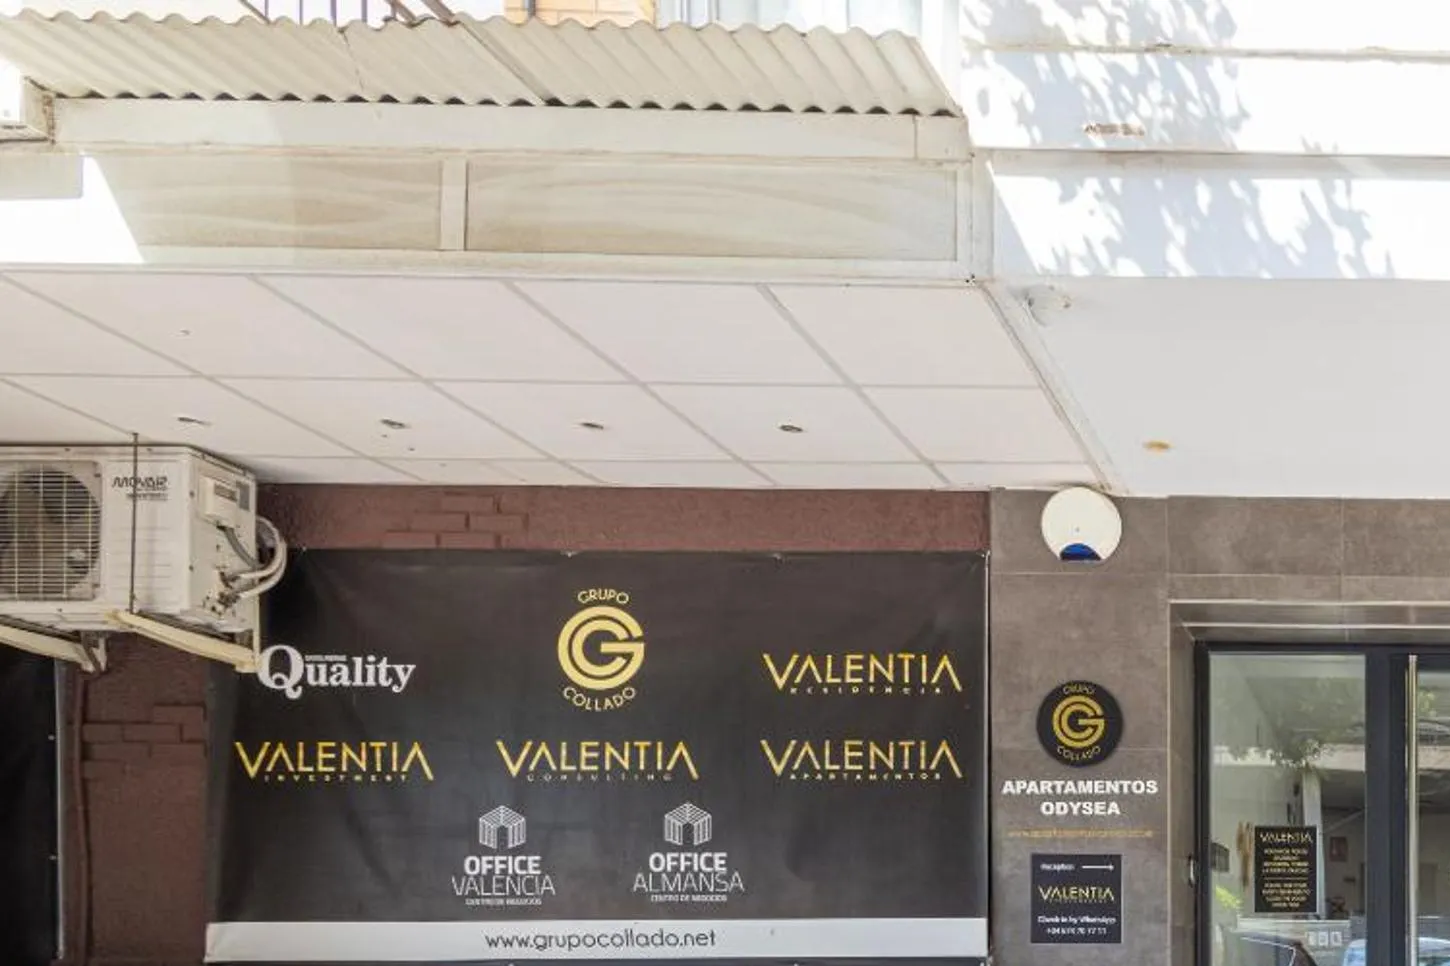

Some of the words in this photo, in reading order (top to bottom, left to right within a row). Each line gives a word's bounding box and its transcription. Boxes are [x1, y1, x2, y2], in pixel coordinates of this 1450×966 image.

[577, 588, 629, 605] GRUPO
[257, 644, 417, 699] Quality
[762, 652, 963, 692] VALENTIA
[563, 686, 636, 711] COLLADO
[234, 741, 434, 781] VALENTIA
[496, 740, 700, 780] VALENTIA
[760, 739, 963, 779] VALENTIA
[1002, 780, 1158, 795] APARTAMENTOS
[1040, 801, 1121, 816] ODYSEA
[464, 855, 542, 875] OFFICE
[649, 851, 728, 872] OFFICE
[451, 875, 556, 896] VALENCIA
[633, 870, 745, 893] ALMANSA
[1038, 886, 1114, 901] VALENTIA
[484, 928, 716, 950] www.grupocollado.net
